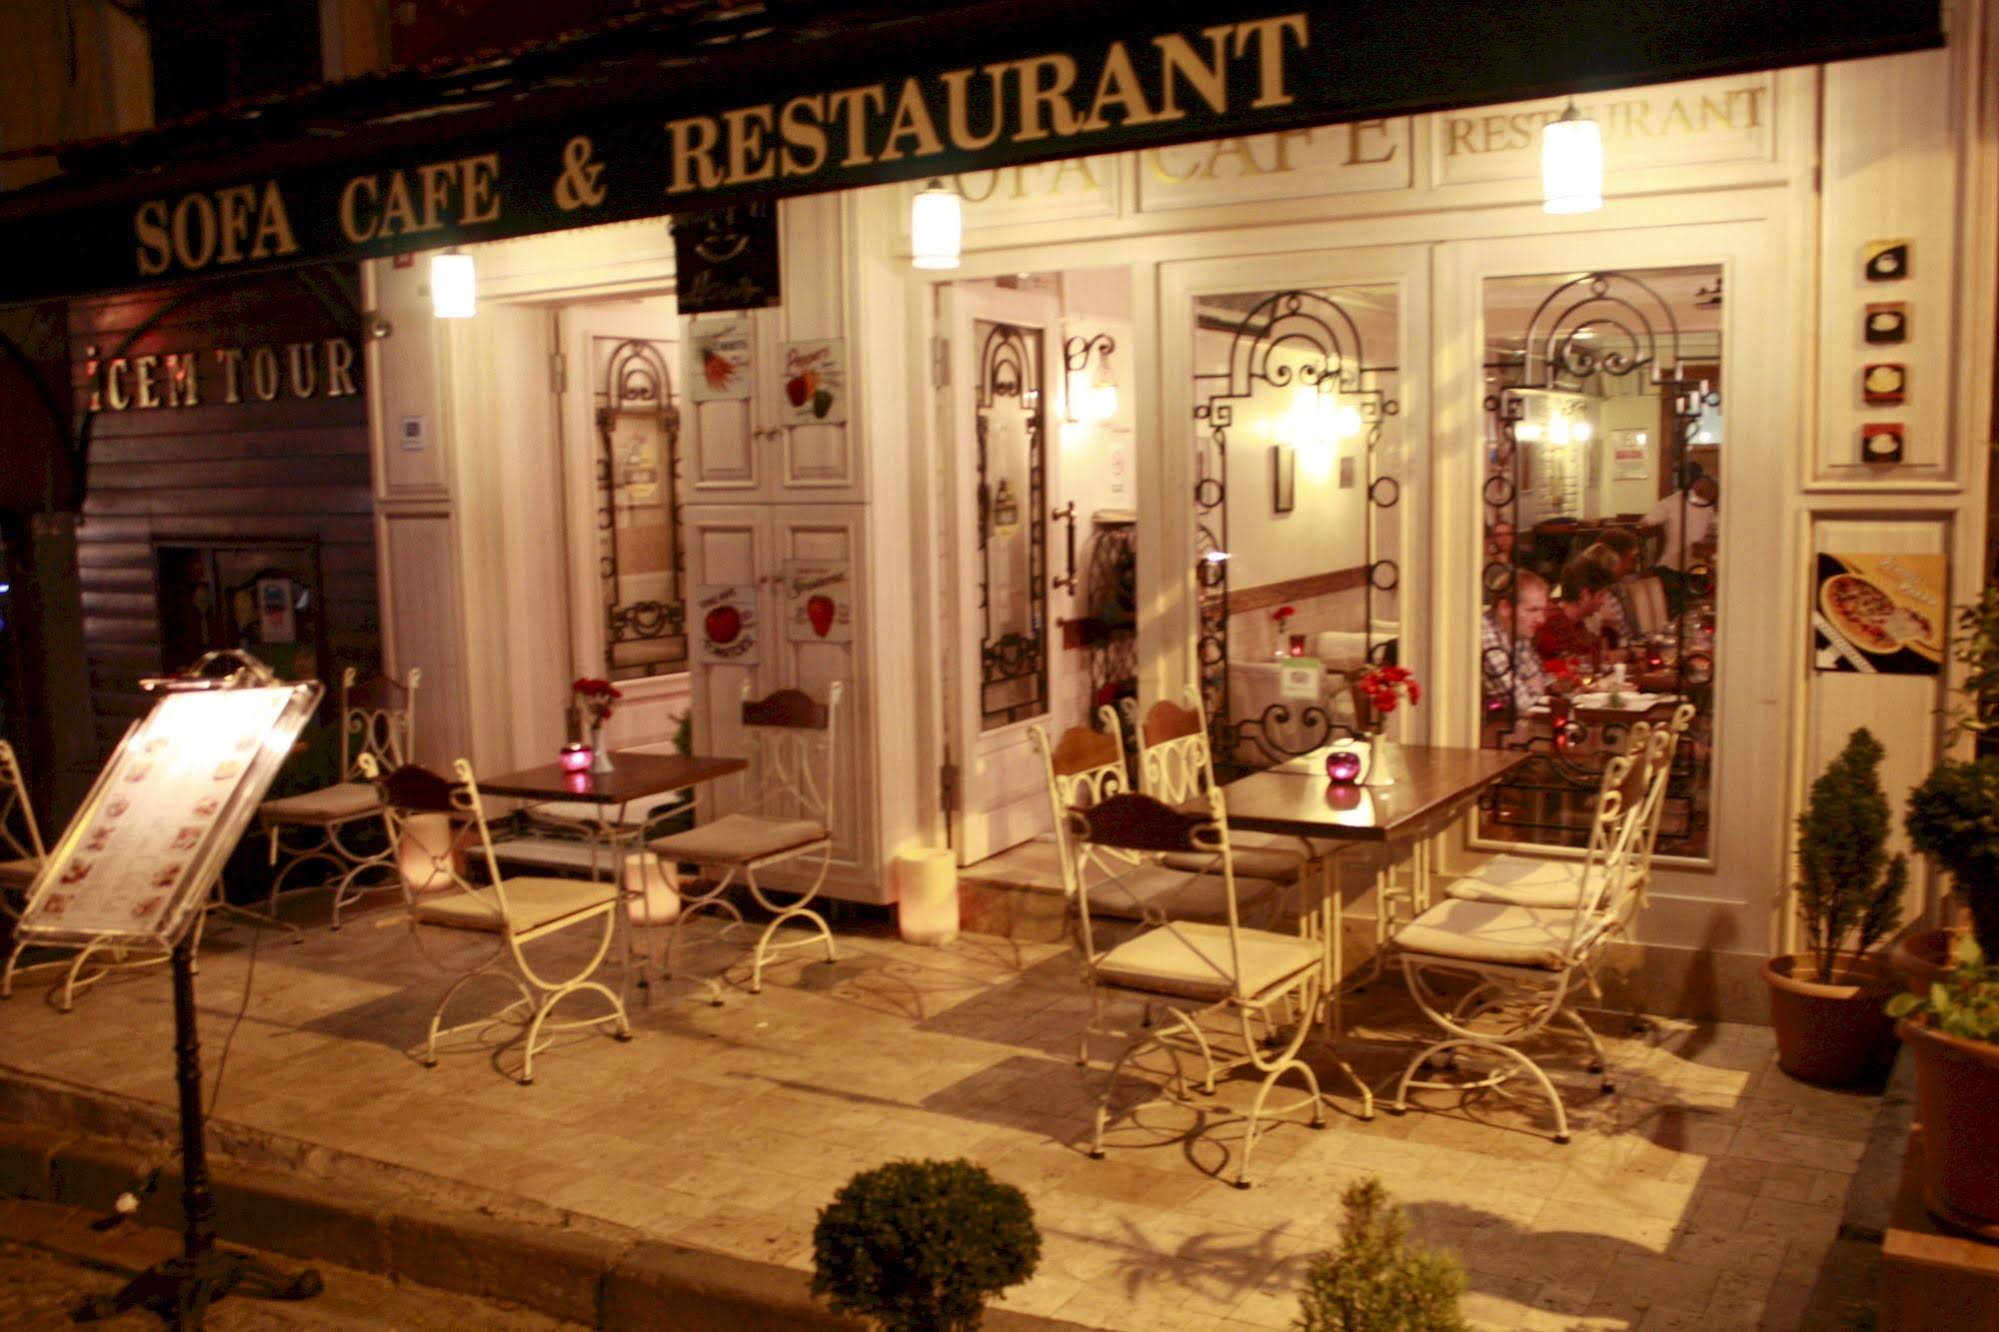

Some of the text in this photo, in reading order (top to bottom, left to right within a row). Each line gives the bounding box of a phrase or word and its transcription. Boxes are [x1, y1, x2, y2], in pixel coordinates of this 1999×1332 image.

[134, 12, 1309, 276] SOFA CAFE & RESTAURANT
[953, 156, 1101, 203] OFA
[213, 338, 356, 403] TOUR
